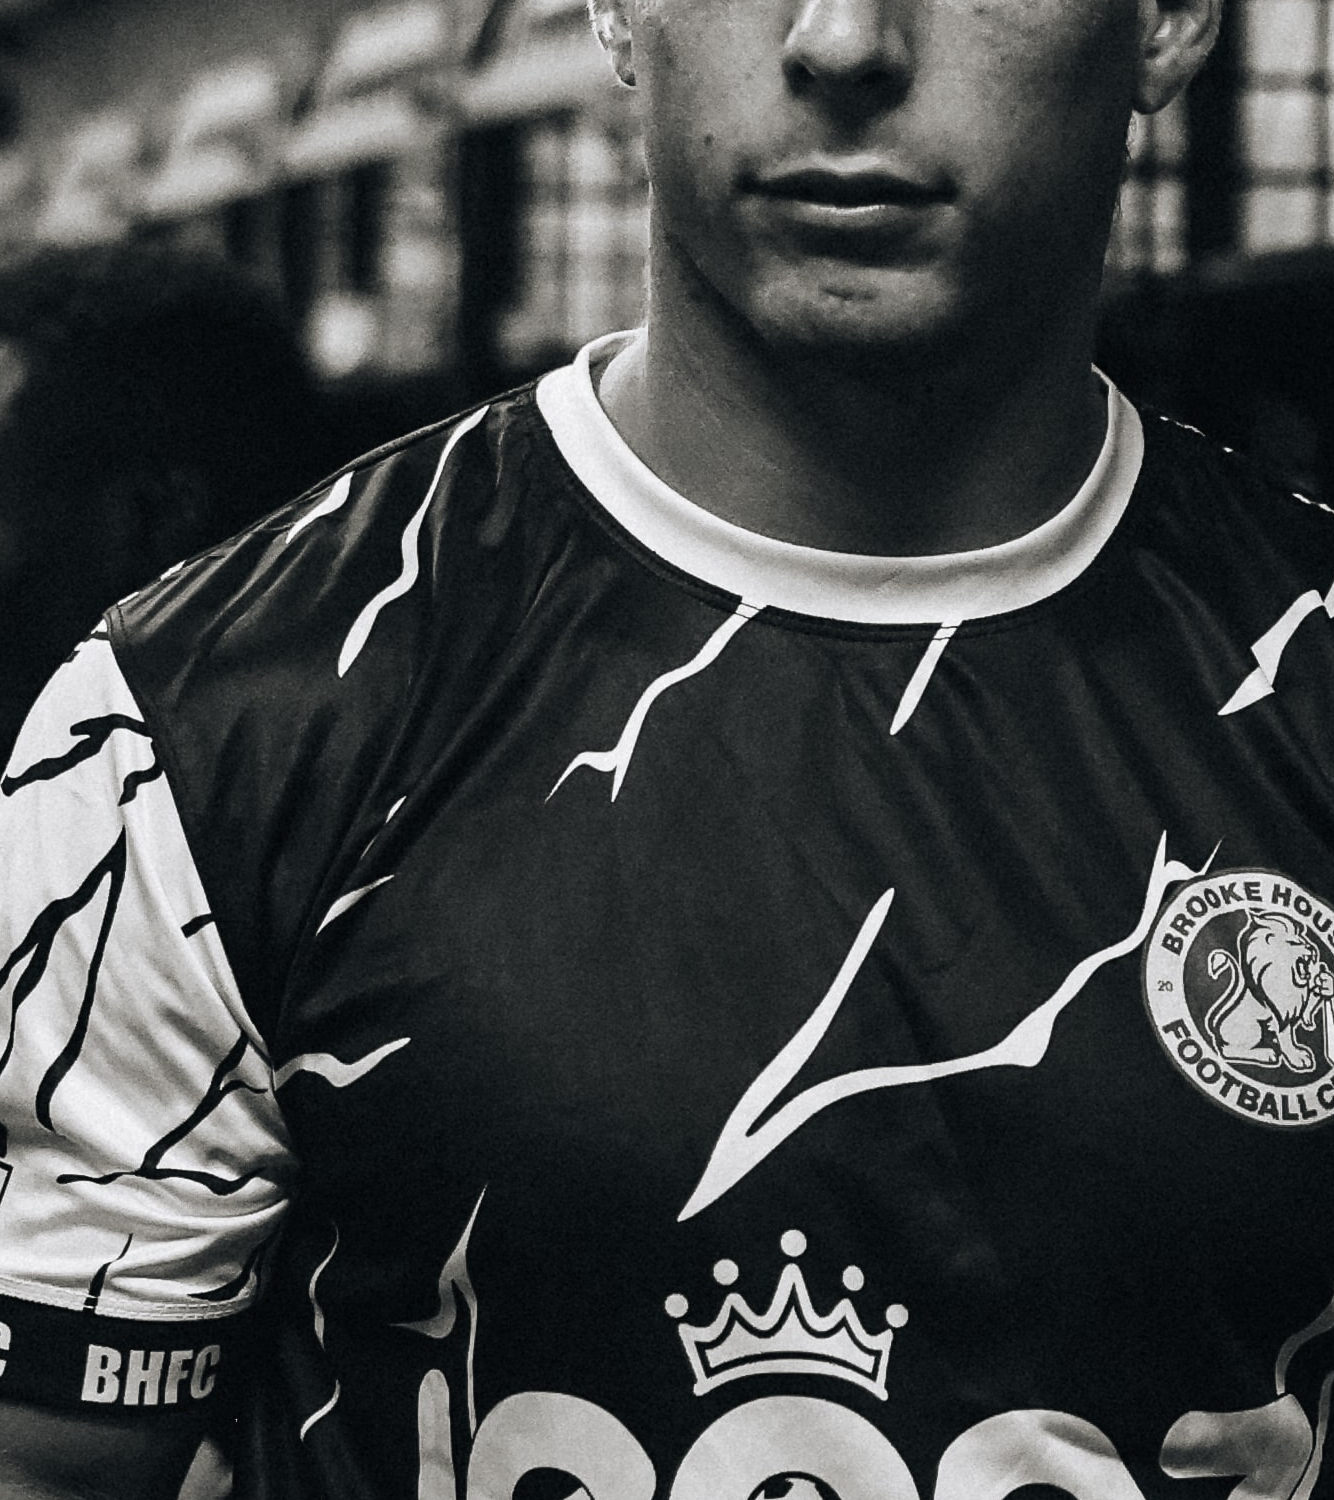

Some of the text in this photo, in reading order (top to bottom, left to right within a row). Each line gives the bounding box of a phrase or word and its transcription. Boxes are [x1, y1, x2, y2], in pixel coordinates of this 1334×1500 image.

[1161, 881, 1263, 956] BROOKE
[1157, 980, 1173, 992] 20
[1162, 1018, 1317, 1121] FOOTBALL
[80, 1344, 222, 1406] BHFC
